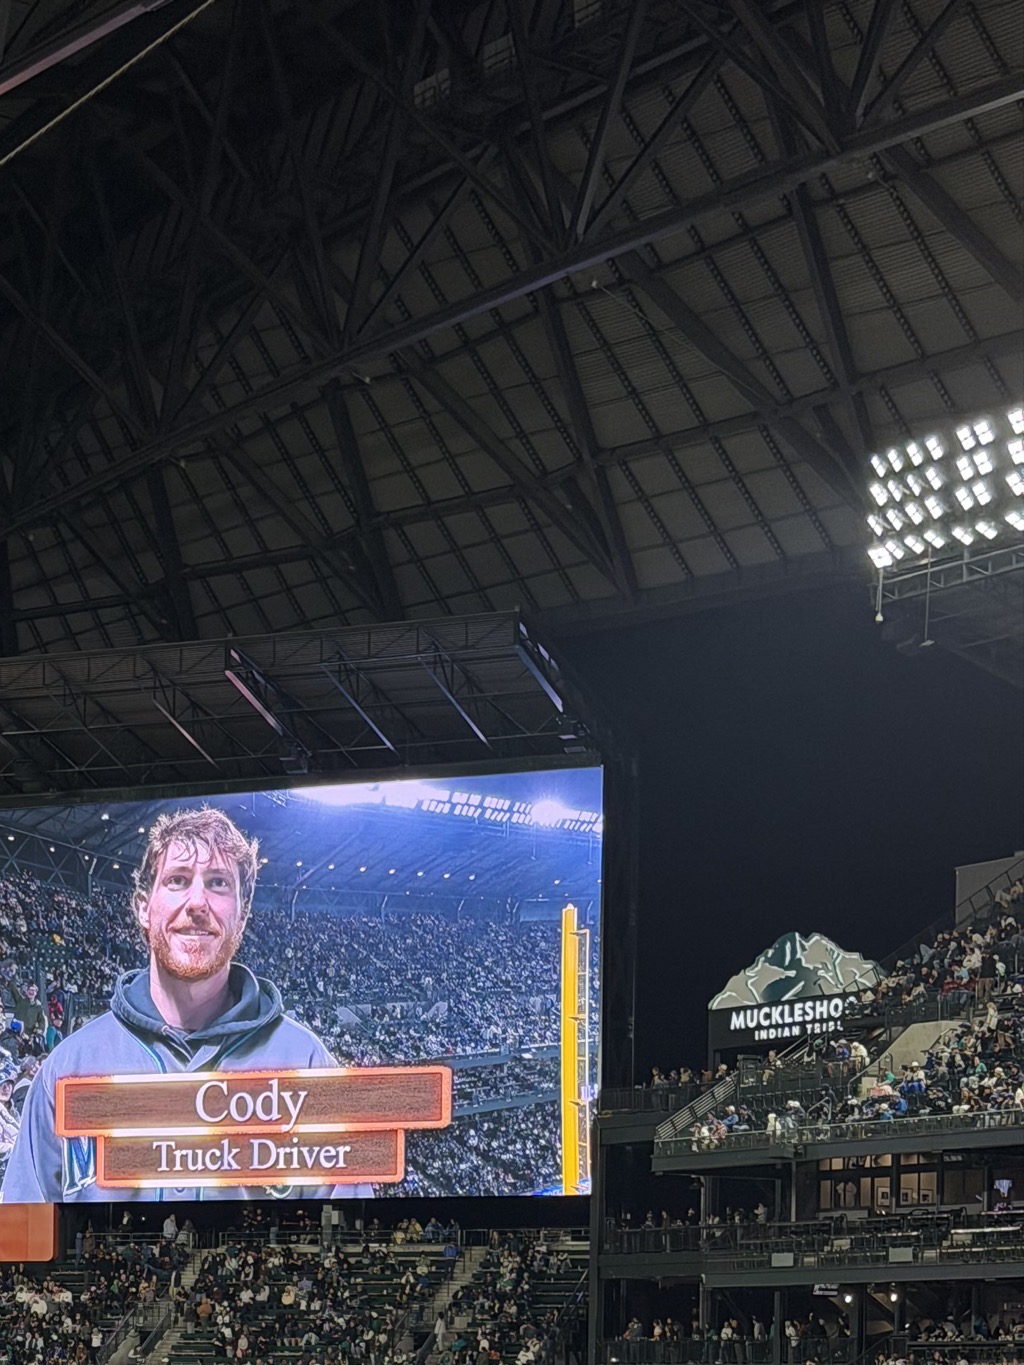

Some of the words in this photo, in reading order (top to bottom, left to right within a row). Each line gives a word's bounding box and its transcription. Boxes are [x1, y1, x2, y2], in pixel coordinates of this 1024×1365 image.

[730, 996, 857, 1030] MUCKLESHO
[754, 1025, 800, 1041] INDIAN
[195, 1078, 308, 1133] Cody
[153, 1138, 241, 1172] Truck
[249, 1137, 351, 1171] Driver
